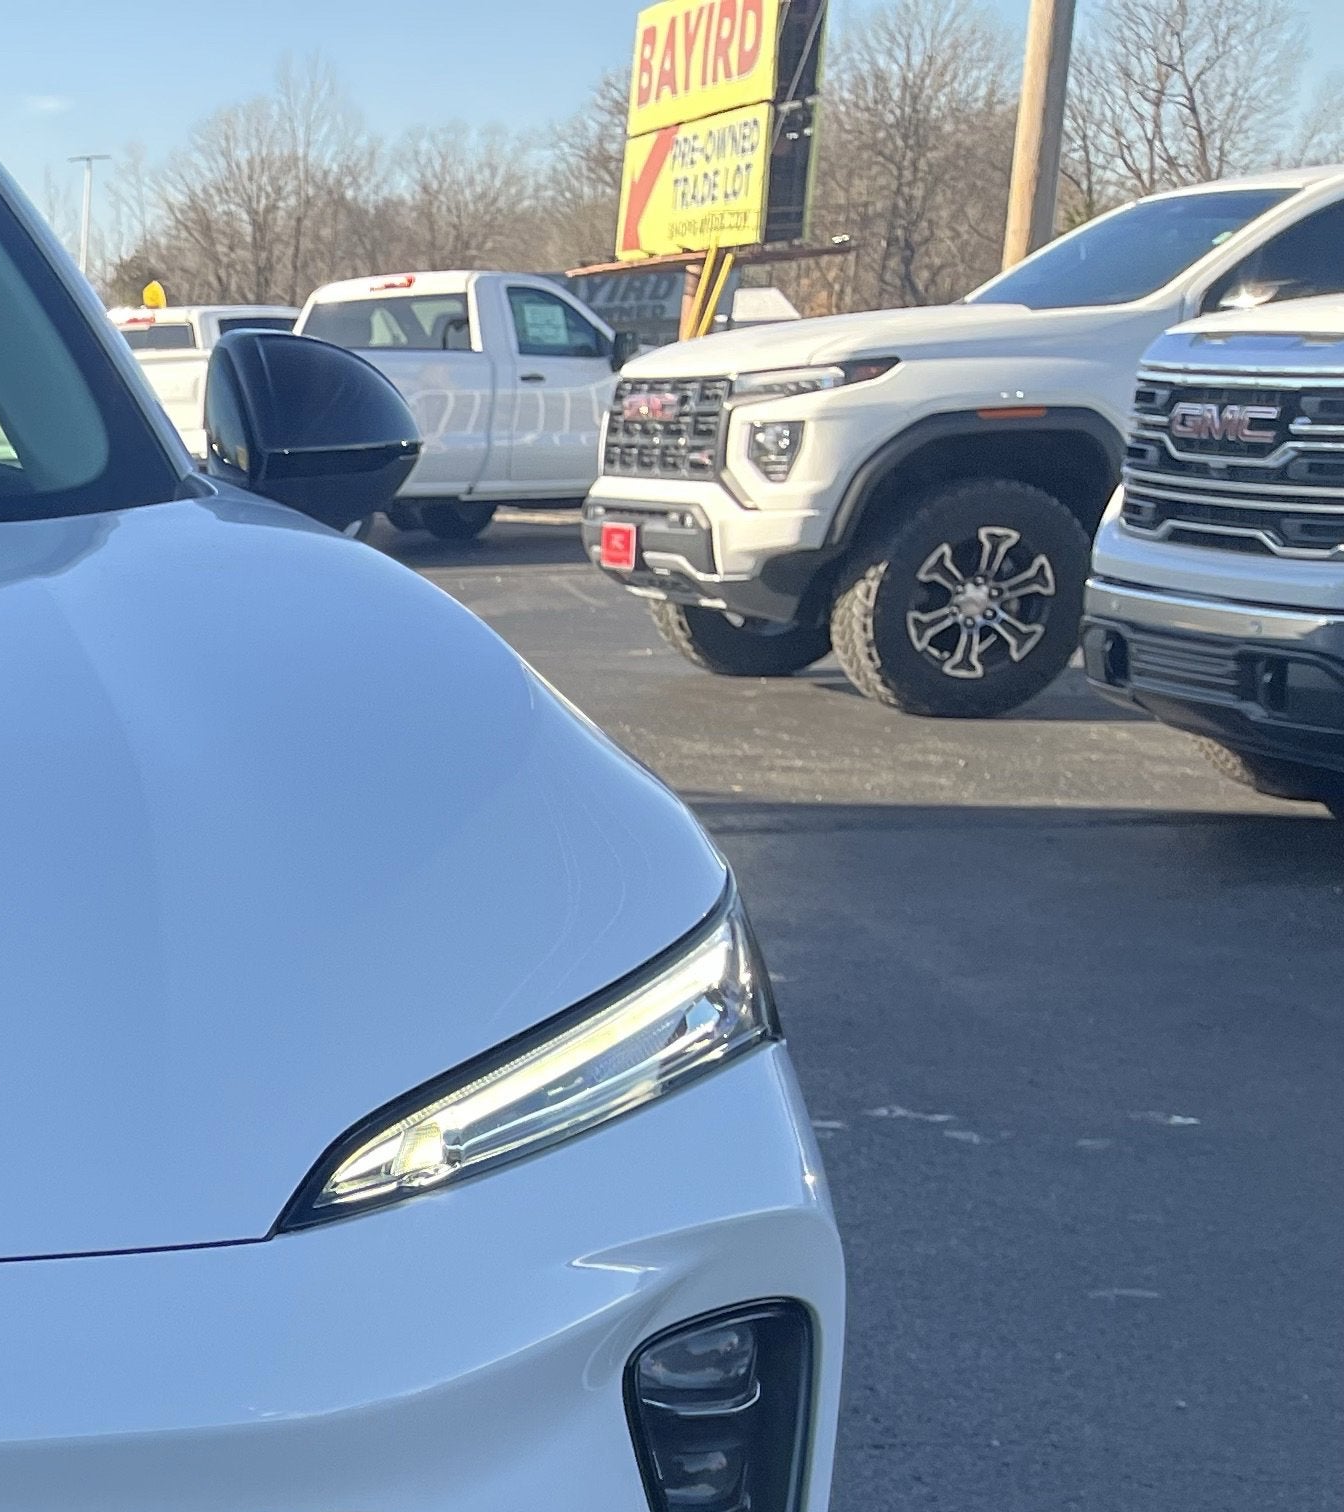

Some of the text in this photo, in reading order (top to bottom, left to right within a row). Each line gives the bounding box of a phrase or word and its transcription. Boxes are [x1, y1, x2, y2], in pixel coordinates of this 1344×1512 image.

[637, 0, 762, 109] BAYIRD
[671, 118, 760, 170] PRE-OWNED
[673, 163, 754, 210] TRADE LOT
[1170, 402, 1281, 443] GMC
